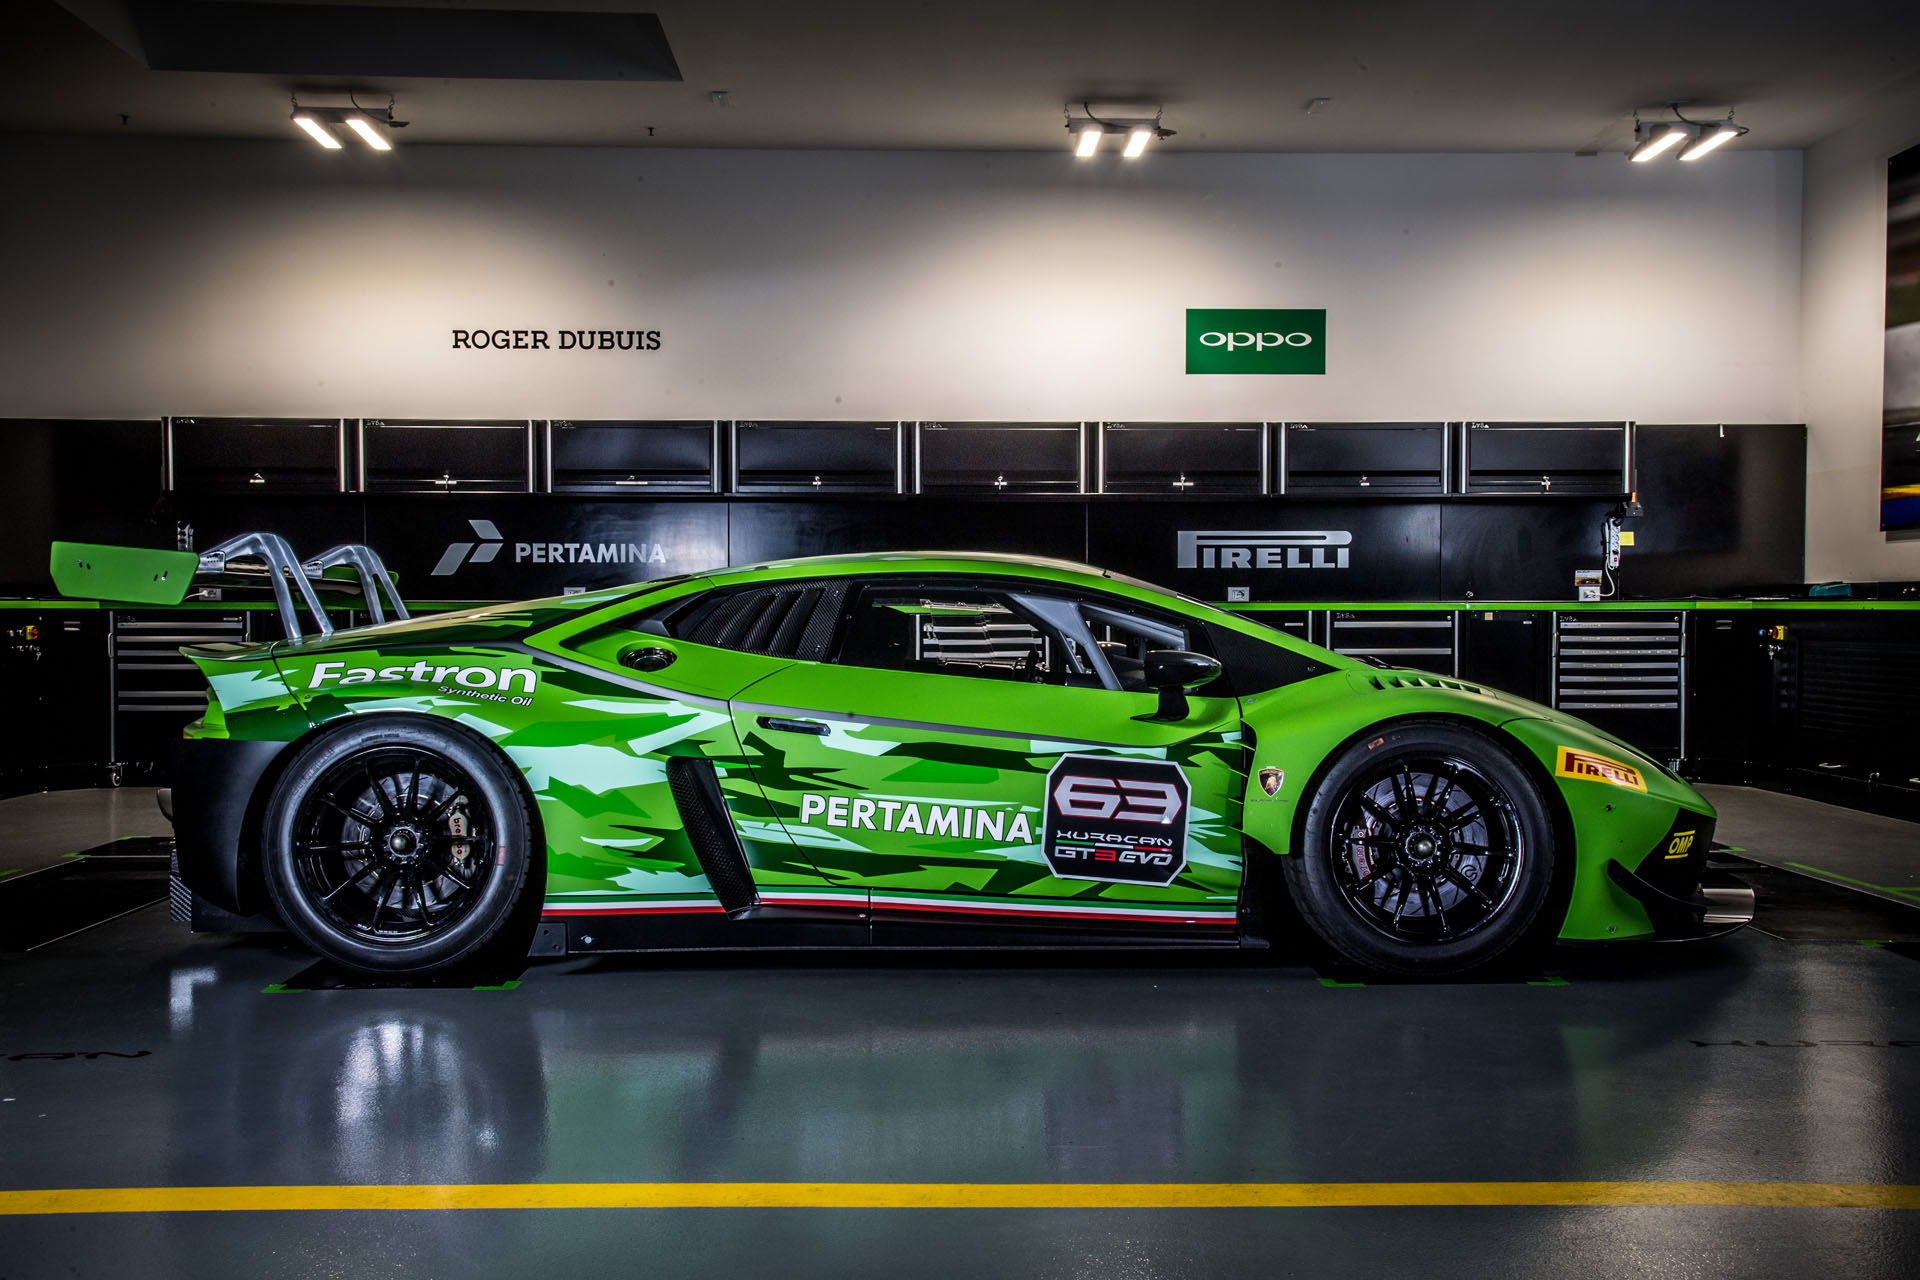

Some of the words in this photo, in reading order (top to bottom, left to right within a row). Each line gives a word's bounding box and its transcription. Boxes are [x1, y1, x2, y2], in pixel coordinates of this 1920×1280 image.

[452, 329, 550, 350] ROGER
[558, 330, 661, 350] DUBUIS
[1199, 331, 1313, 352] oppo
[515, 542, 667, 563] PERTAMINA
[1177, 530, 1353, 569] PIRELLI
[307, 660, 538, 693] Fastron
[437, 685, 507, 704] Synthetic
[510, 696, 533, 707] Oil
[1564, 752, 1640, 786] PIRELLI
[1053, 775, 1183, 825] 63
[800, 793, 1034, 844] PERTAMINA
[453, 817, 463, 855] brebo
[1668, 835, 1694, 855] OMP
[1054, 845, 1117, 862] GT3
[1118, 850, 1173, 866] EVO
